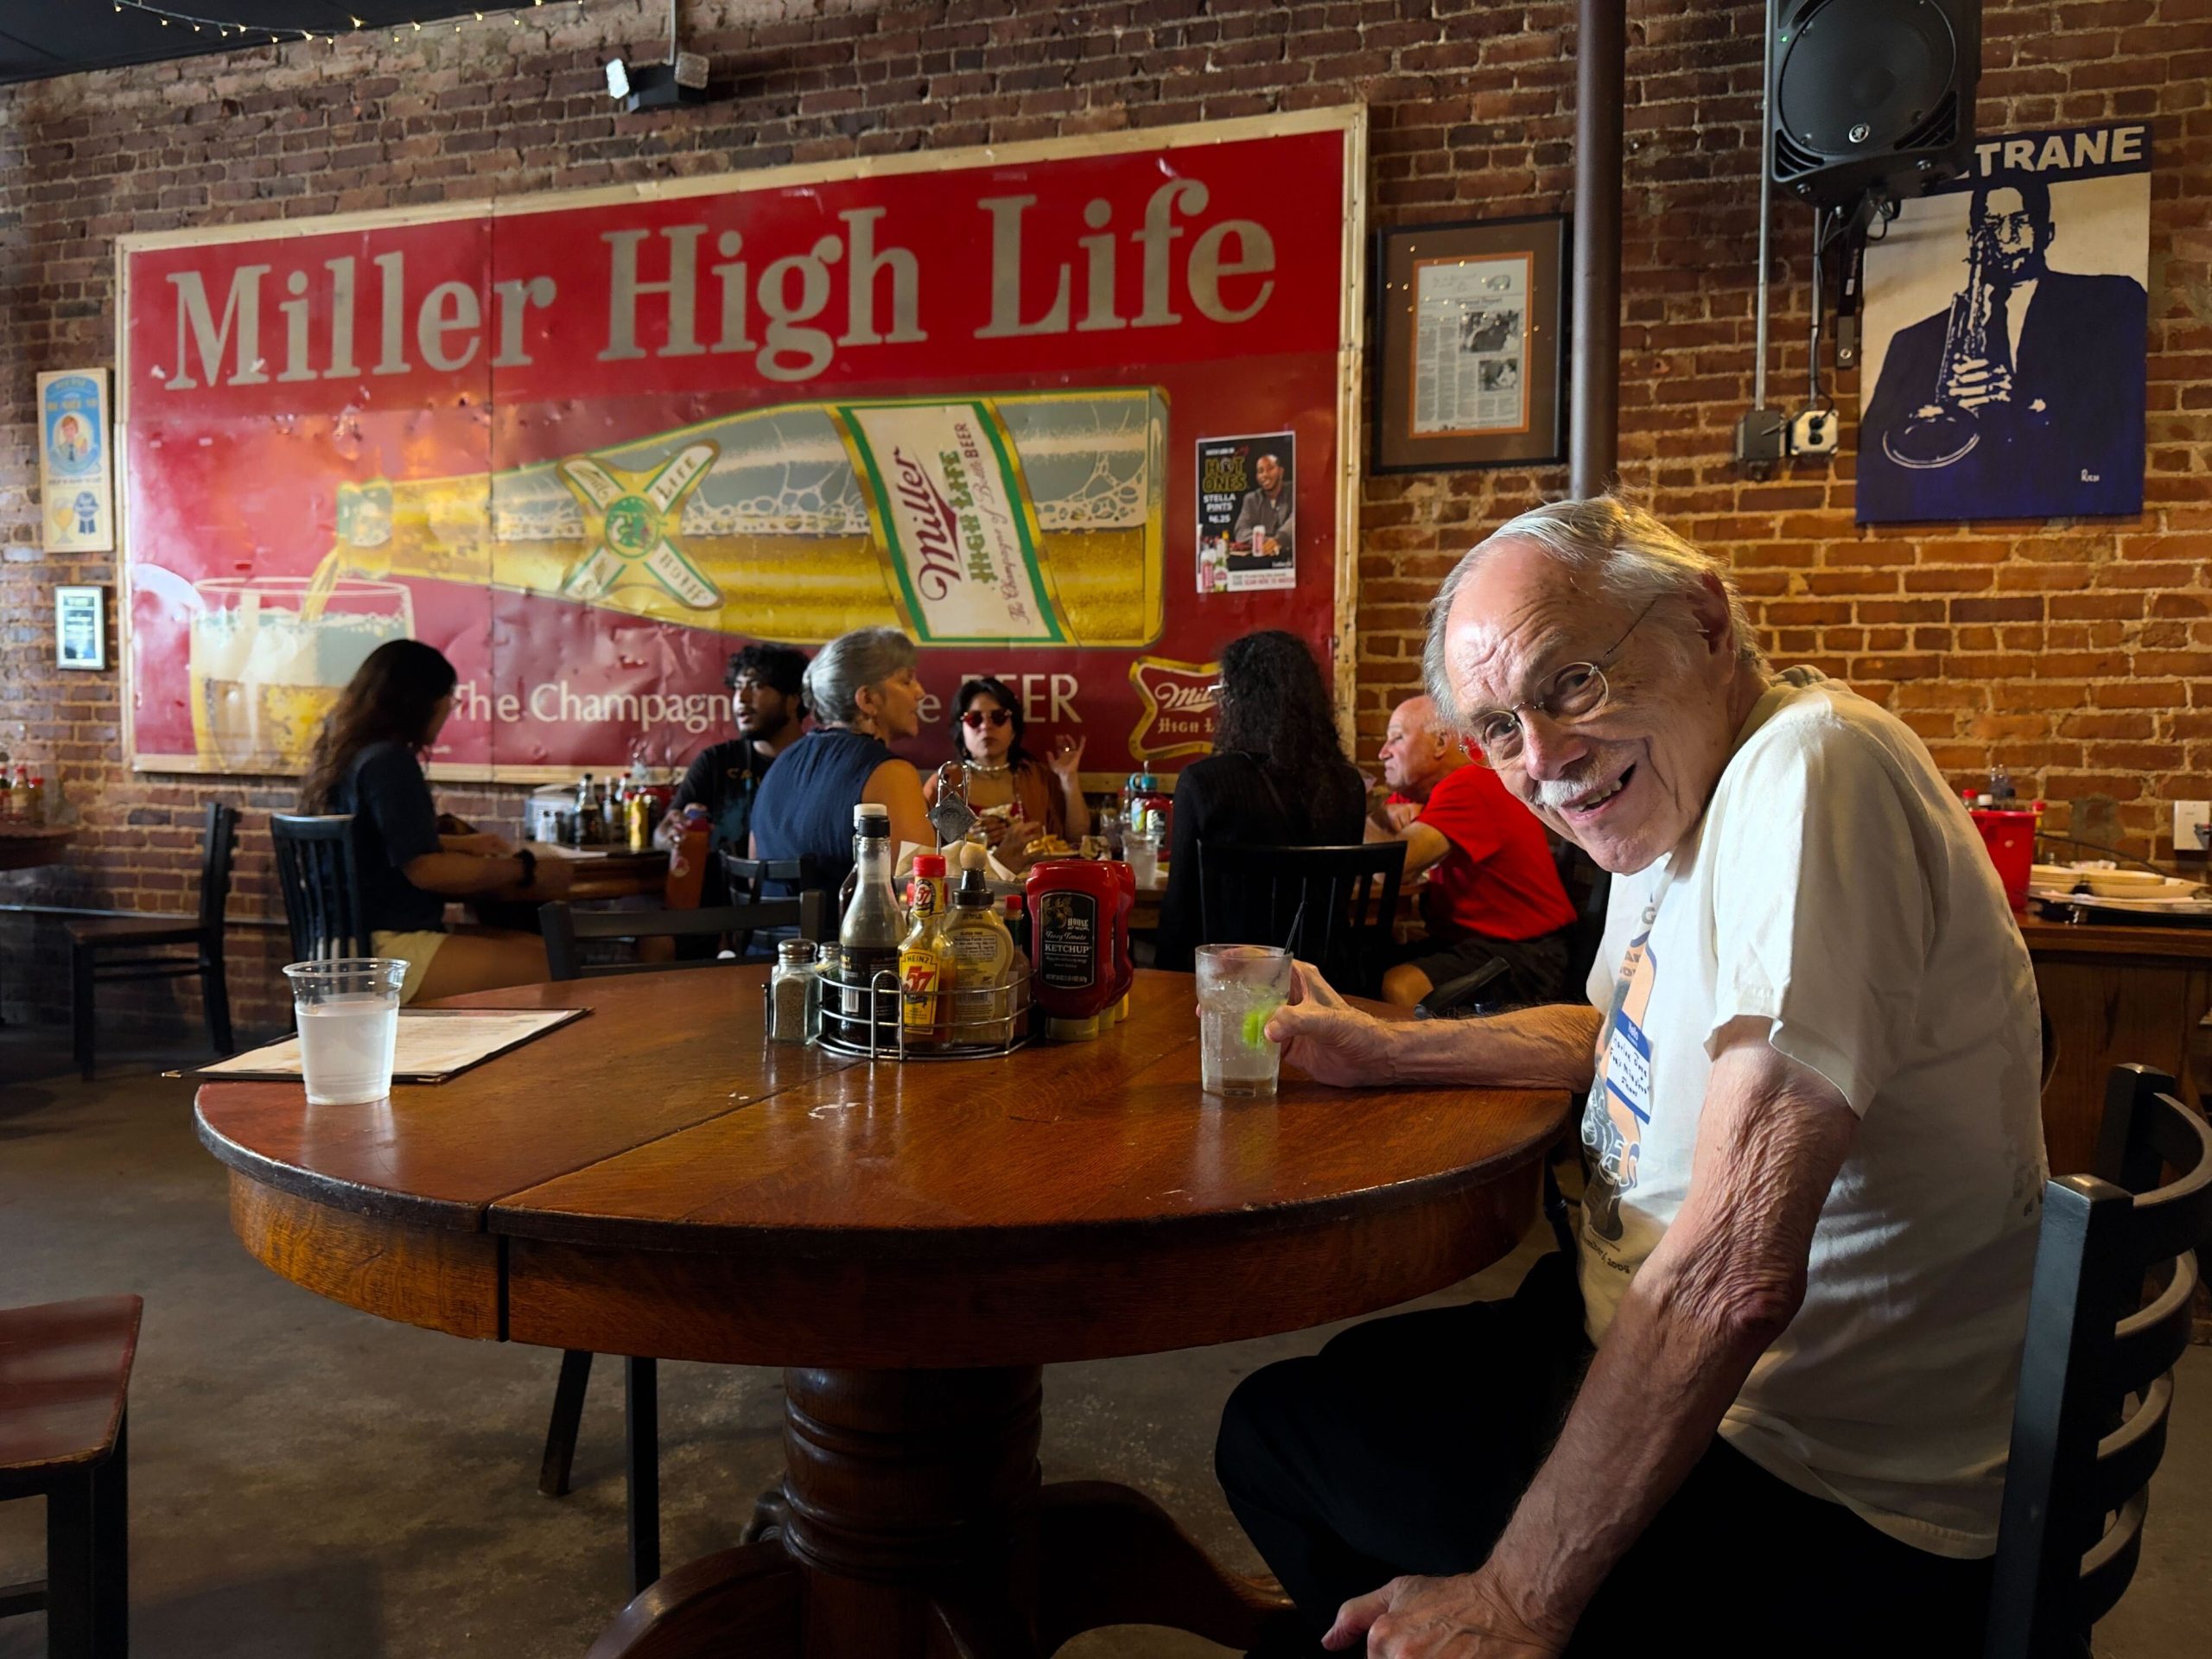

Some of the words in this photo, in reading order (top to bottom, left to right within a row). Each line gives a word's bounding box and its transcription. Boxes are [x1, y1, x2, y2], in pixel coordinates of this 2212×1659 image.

[1955, 125, 2145, 180] TRANE
[165, 251, 557, 391] Miller
[597, 207, 928, 382] High
[974, 177, 1276, 339] Life
[954, 423, 980, 460] BEER
[1203, 493, 1236, 504] STELLA
[893, 446, 963, 601] Miller
[455, 680, 521, 722] The
[530, 680, 730, 734] Champagn
[961, 674, 1083, 723] ER
[1154, 682, 1213, 709] Mil
[906, 955, 930, 964] HEINZ
[1045, 944, 1089, 954] KETCHUP
[903, 965, 935, 992] 57
